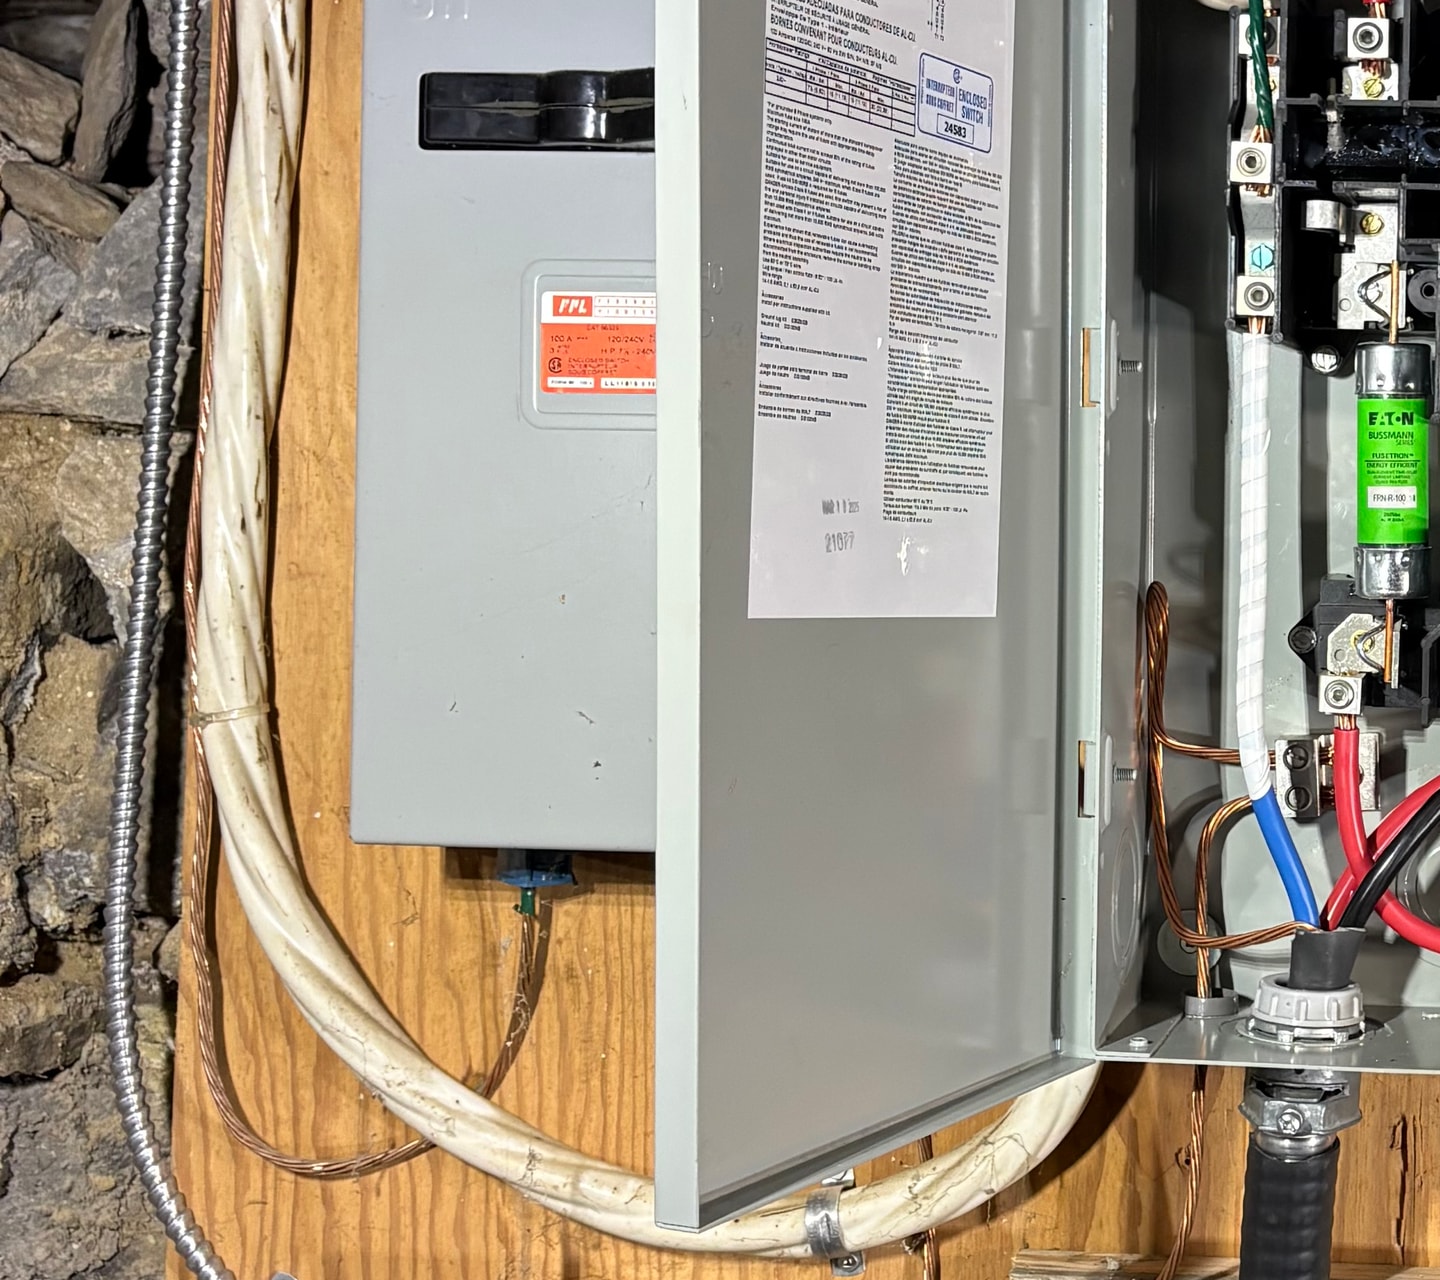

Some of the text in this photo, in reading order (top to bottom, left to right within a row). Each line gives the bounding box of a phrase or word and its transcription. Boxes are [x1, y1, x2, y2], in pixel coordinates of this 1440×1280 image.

[958, 88, 987, 110] ENCLOSED
[961, 105, 983, 124] SWITCH
[944, 121, 966, 138] 24583
[1368, 431, 1414, 439] BUSSMANN
